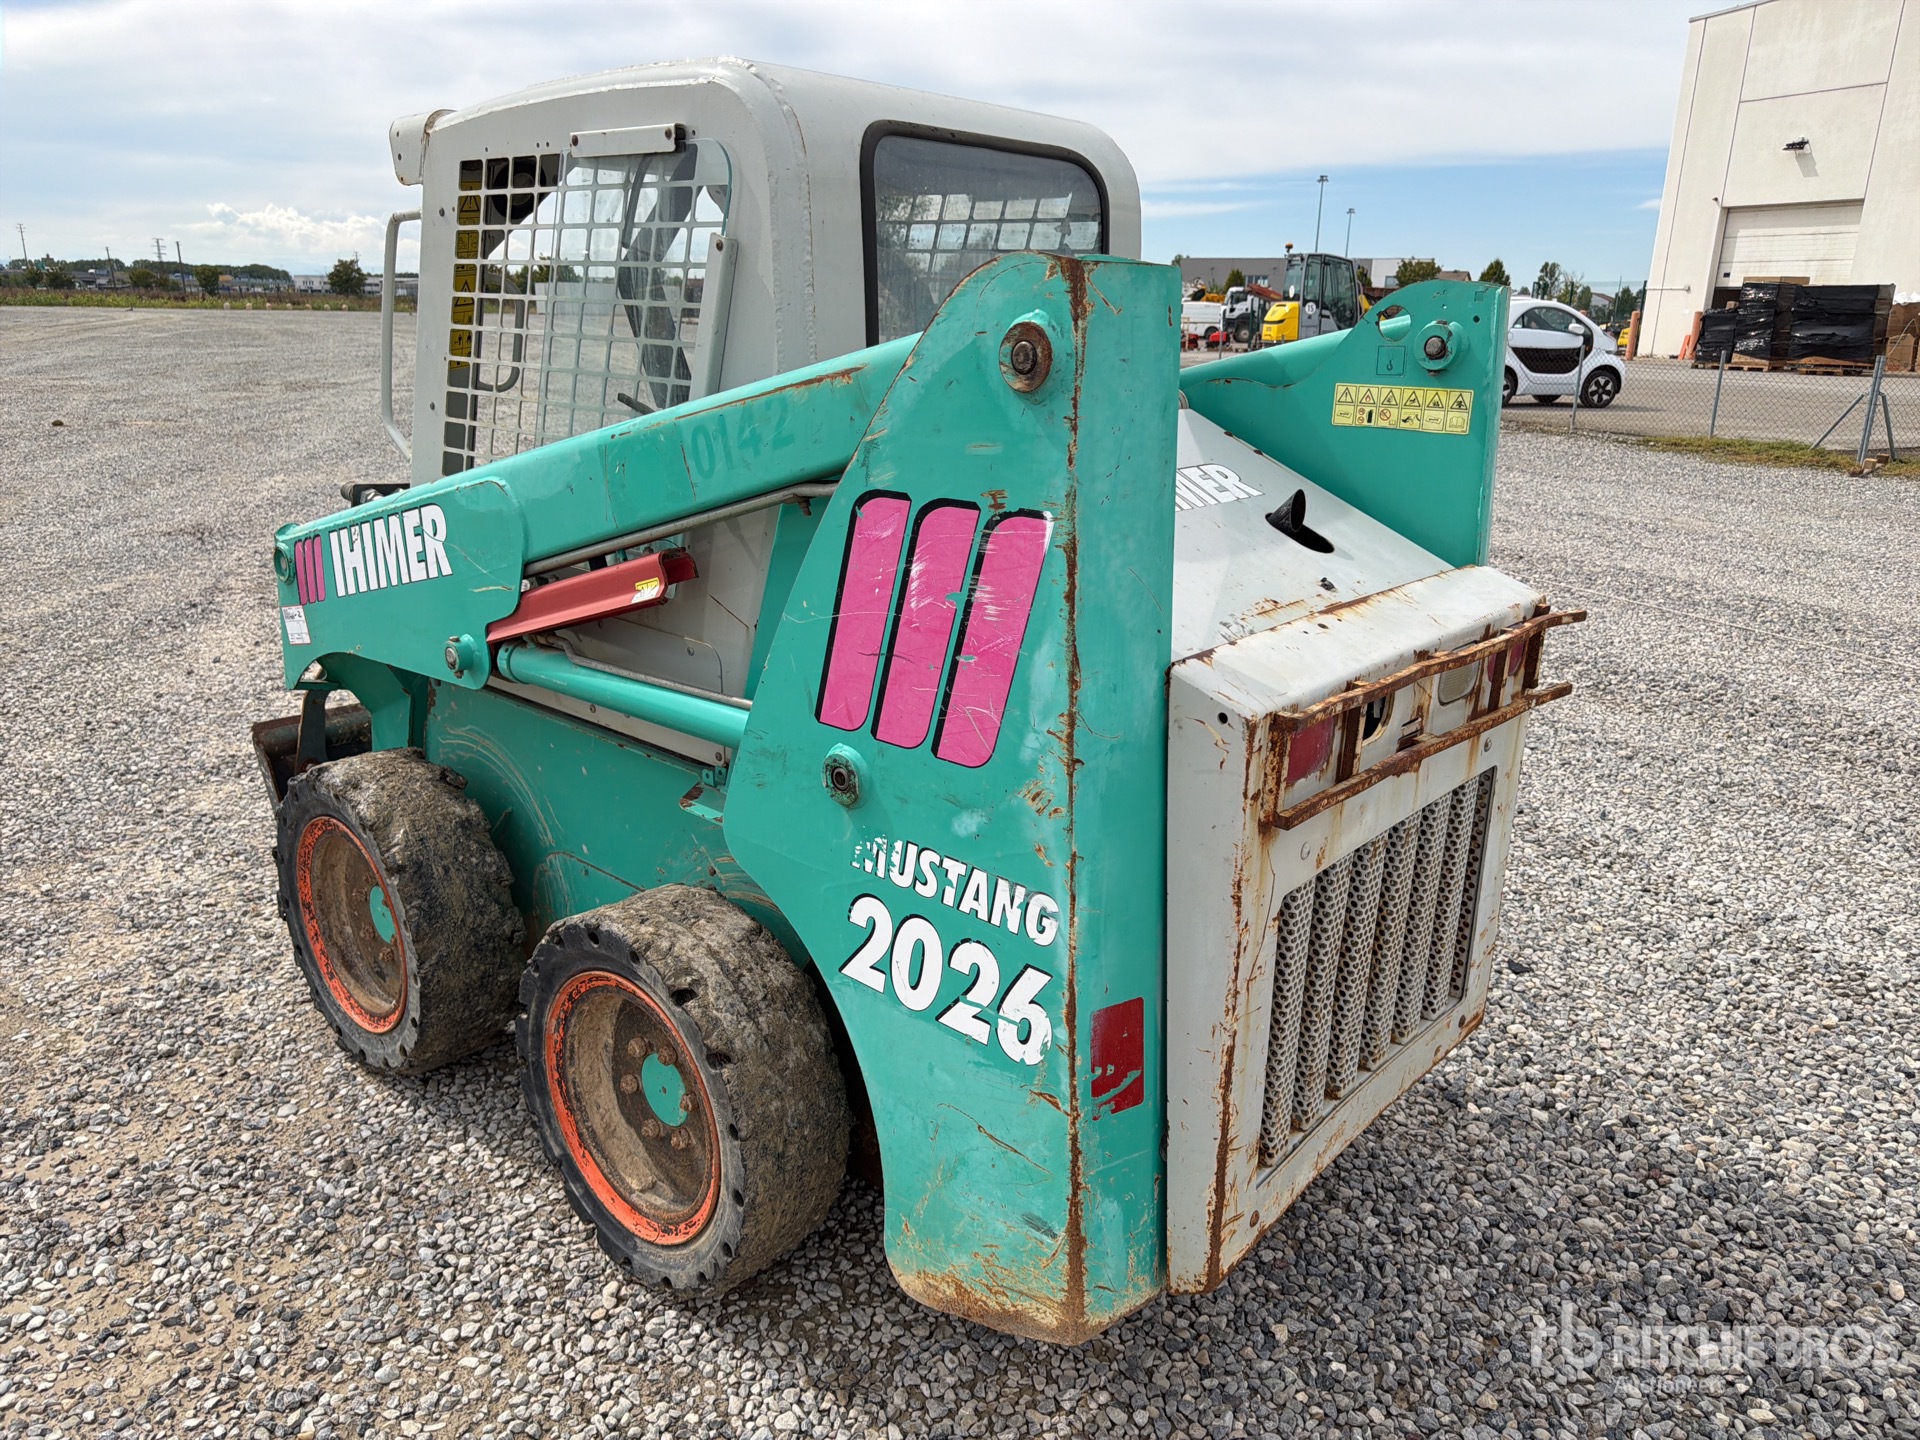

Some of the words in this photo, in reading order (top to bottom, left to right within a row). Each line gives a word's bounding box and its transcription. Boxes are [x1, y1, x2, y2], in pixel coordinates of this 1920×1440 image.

[1175, 463, 1265, 512] MER
[328, 502, 453, 598] IHIMER
[850, 834, 1059, 947] MUSTANG
[839, 892, 1053, 1066] 2026
